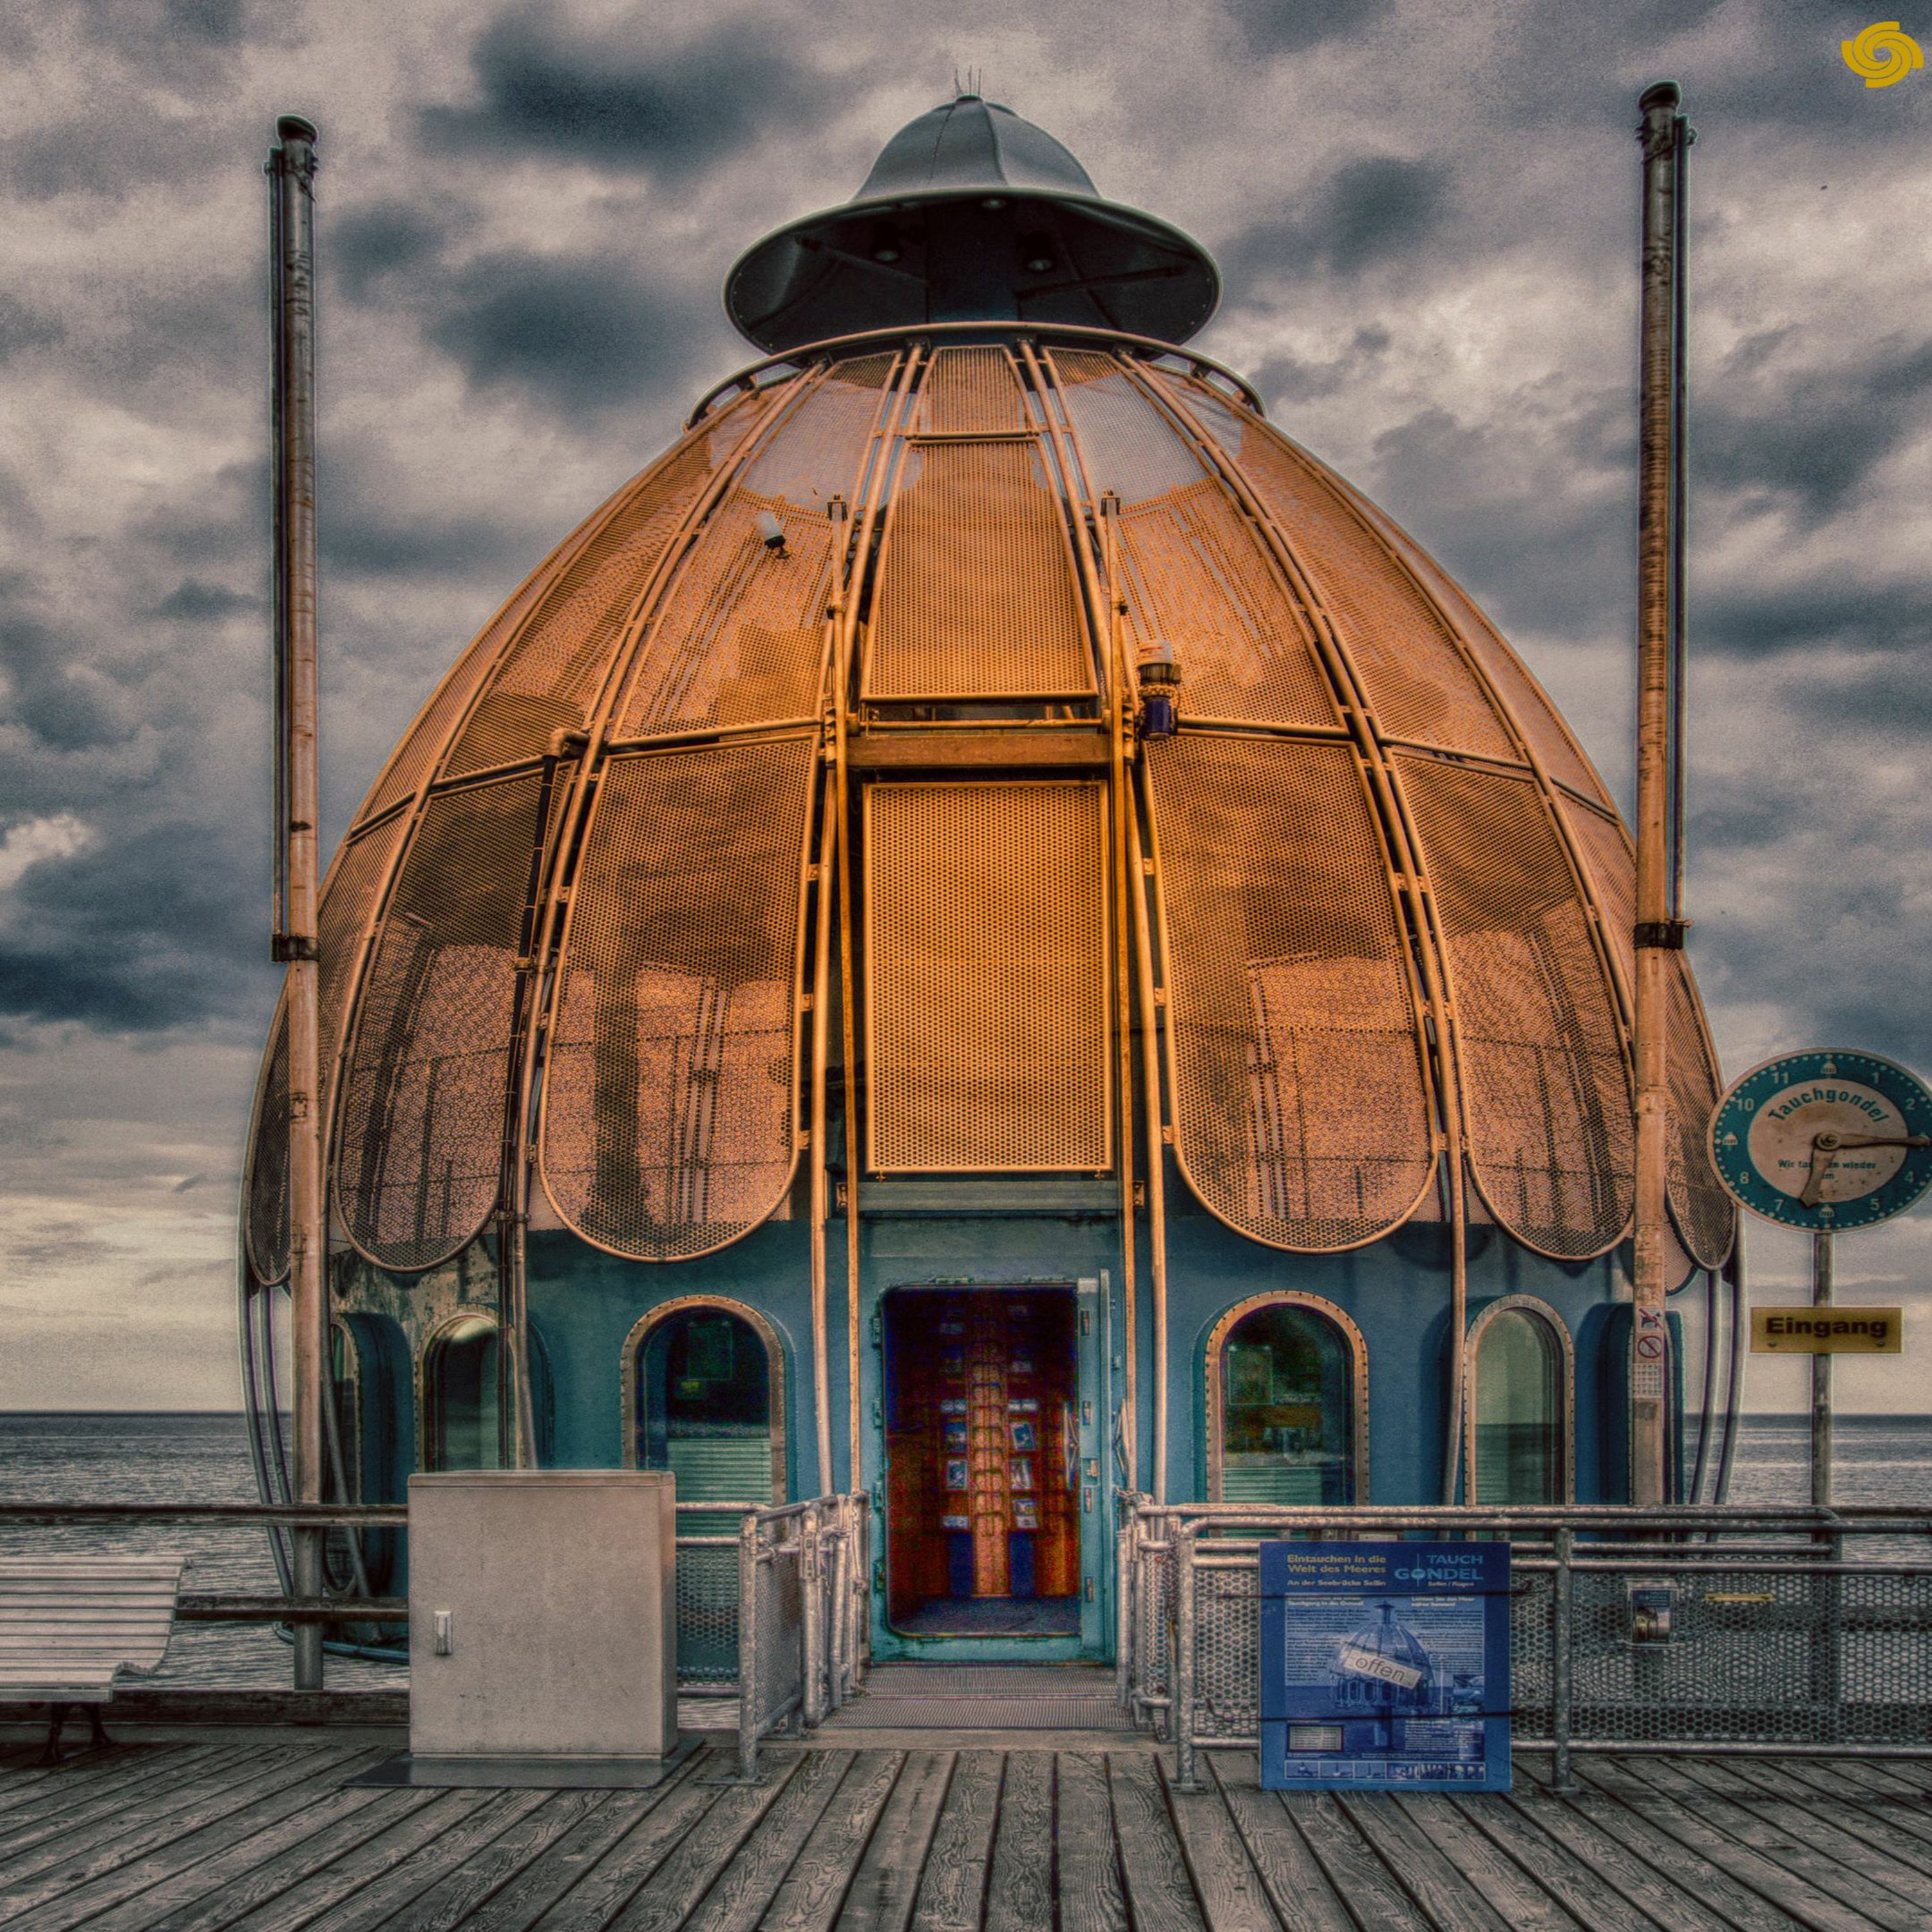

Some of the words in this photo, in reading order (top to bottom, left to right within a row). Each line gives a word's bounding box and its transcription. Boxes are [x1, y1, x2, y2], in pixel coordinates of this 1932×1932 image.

[1772, 1072, 1788, 1083] 11
[1873, 1072, 1880, 1083] 1
[1737, 1099, 1754, 1111] 10
[1768, 1087, 1889, 1122] Tauchgondel
[1906, 1099, 1915, 1110] 2
[1778, 1160, 1794, 1168] Wir
[1740, 1172, 1749, 1184] 8
[1904, 1171, 1914, 1183] 4
[1775, 1200, 1784, 1211] 7
[1871, 1199, 1880, 1211] 5
[1766, 1317, 1888, 1338] Eingang
[1287, 1555, 1351, 1563] Eintauchen
[1426, 1555, 1483, 1564] TAUCH
[1394, 1569, 1484, 1580] GONDEL
[1355, 1658, 1405, 1682] offen
